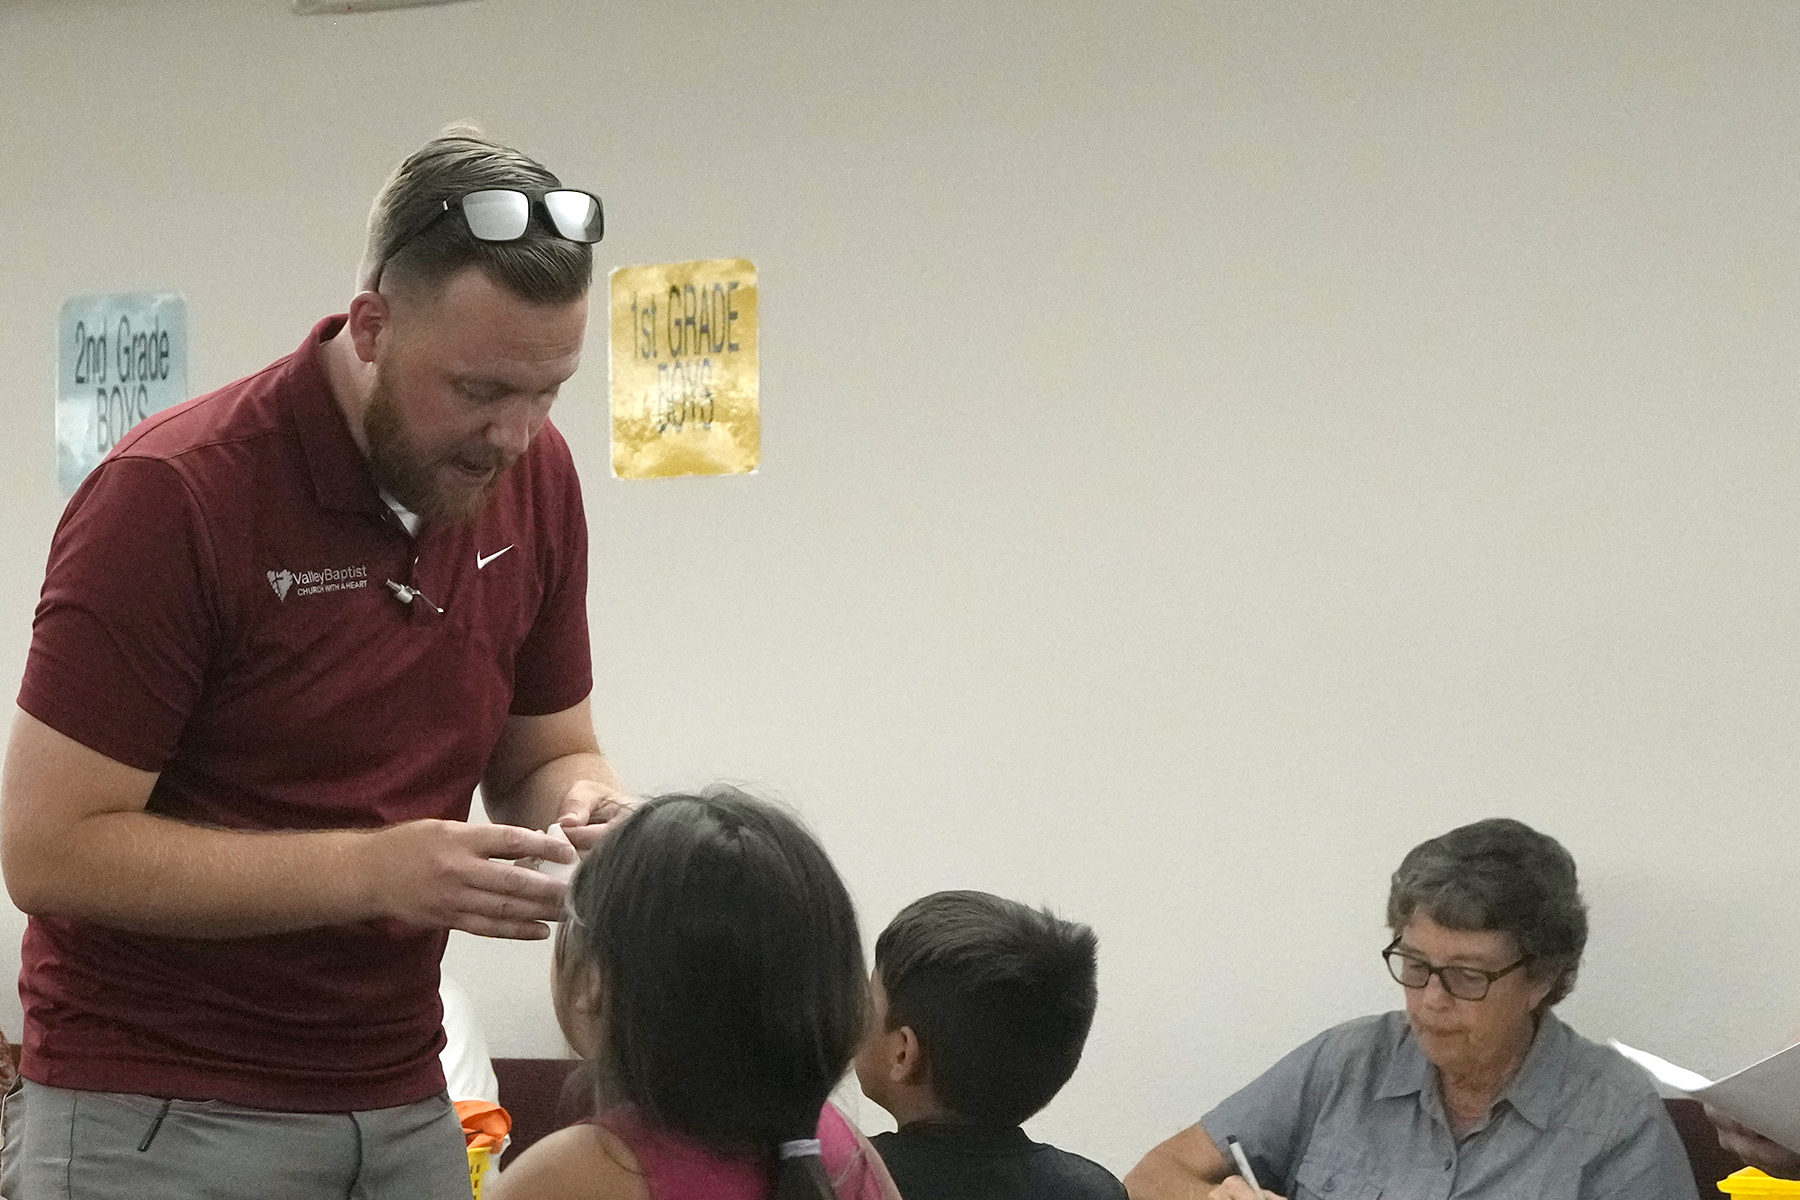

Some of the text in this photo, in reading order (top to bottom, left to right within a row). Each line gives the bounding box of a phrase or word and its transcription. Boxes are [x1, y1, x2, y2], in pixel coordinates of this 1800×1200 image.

[631, 282, 740, 359] 1st GRADE
[74, 313, 170, 384] 2nd Grade
[292, 565, 368, 585] ValleyBaptist
[297, 584, 324, 596] CHURCH
[325, 583, 340, 593] WITH
[346, 579, 368, 590] HEART
